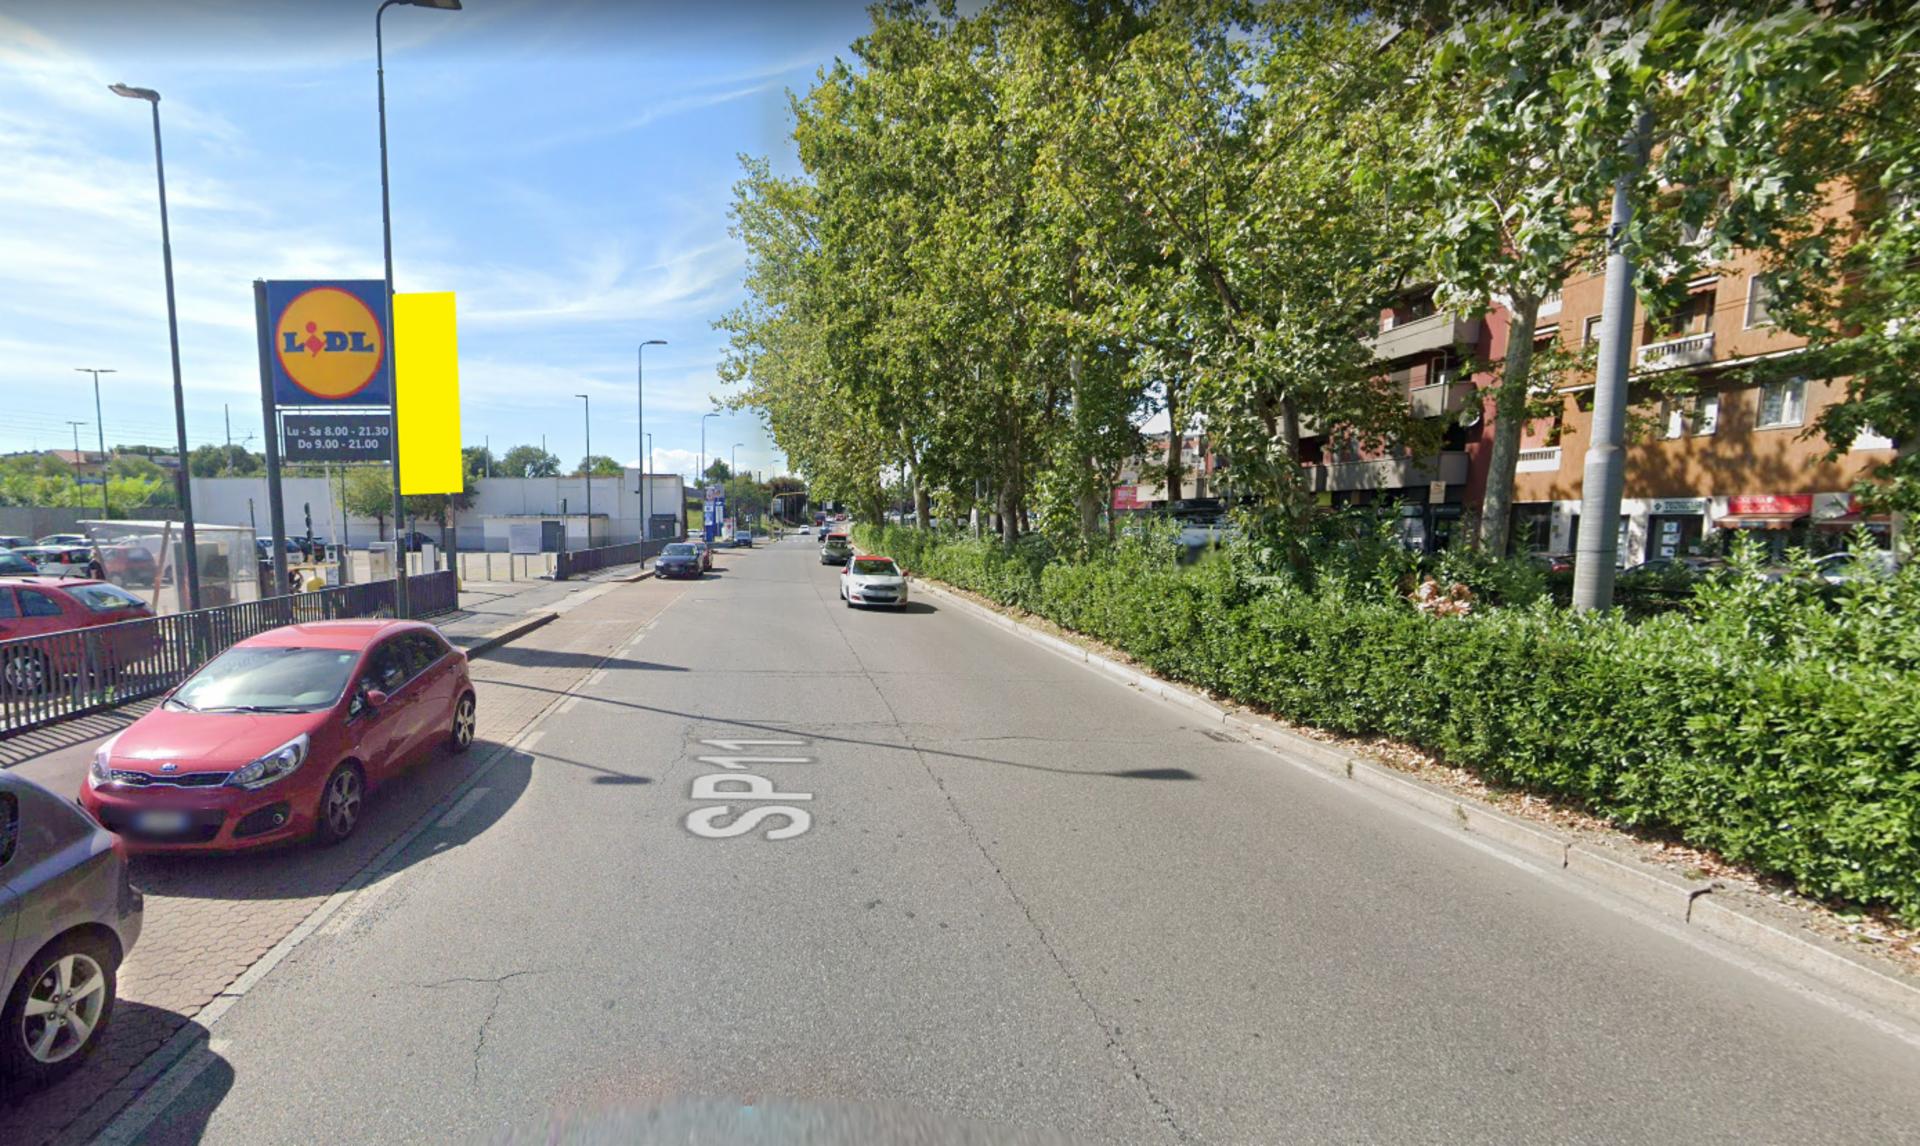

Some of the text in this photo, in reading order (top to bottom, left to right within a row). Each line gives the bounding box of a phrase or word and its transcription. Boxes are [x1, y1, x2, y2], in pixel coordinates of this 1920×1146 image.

[287, 426, 299, 436] Lu
[309, 426, 322, 436] Sa
[324, 426, 349, 436] 8.00
[358, 426, 389, 436] 21.30
[297, 439, 313, 449] Do
[314, 439, 339, 449] 9.00
[348, 439, 379, 449] 21.00
